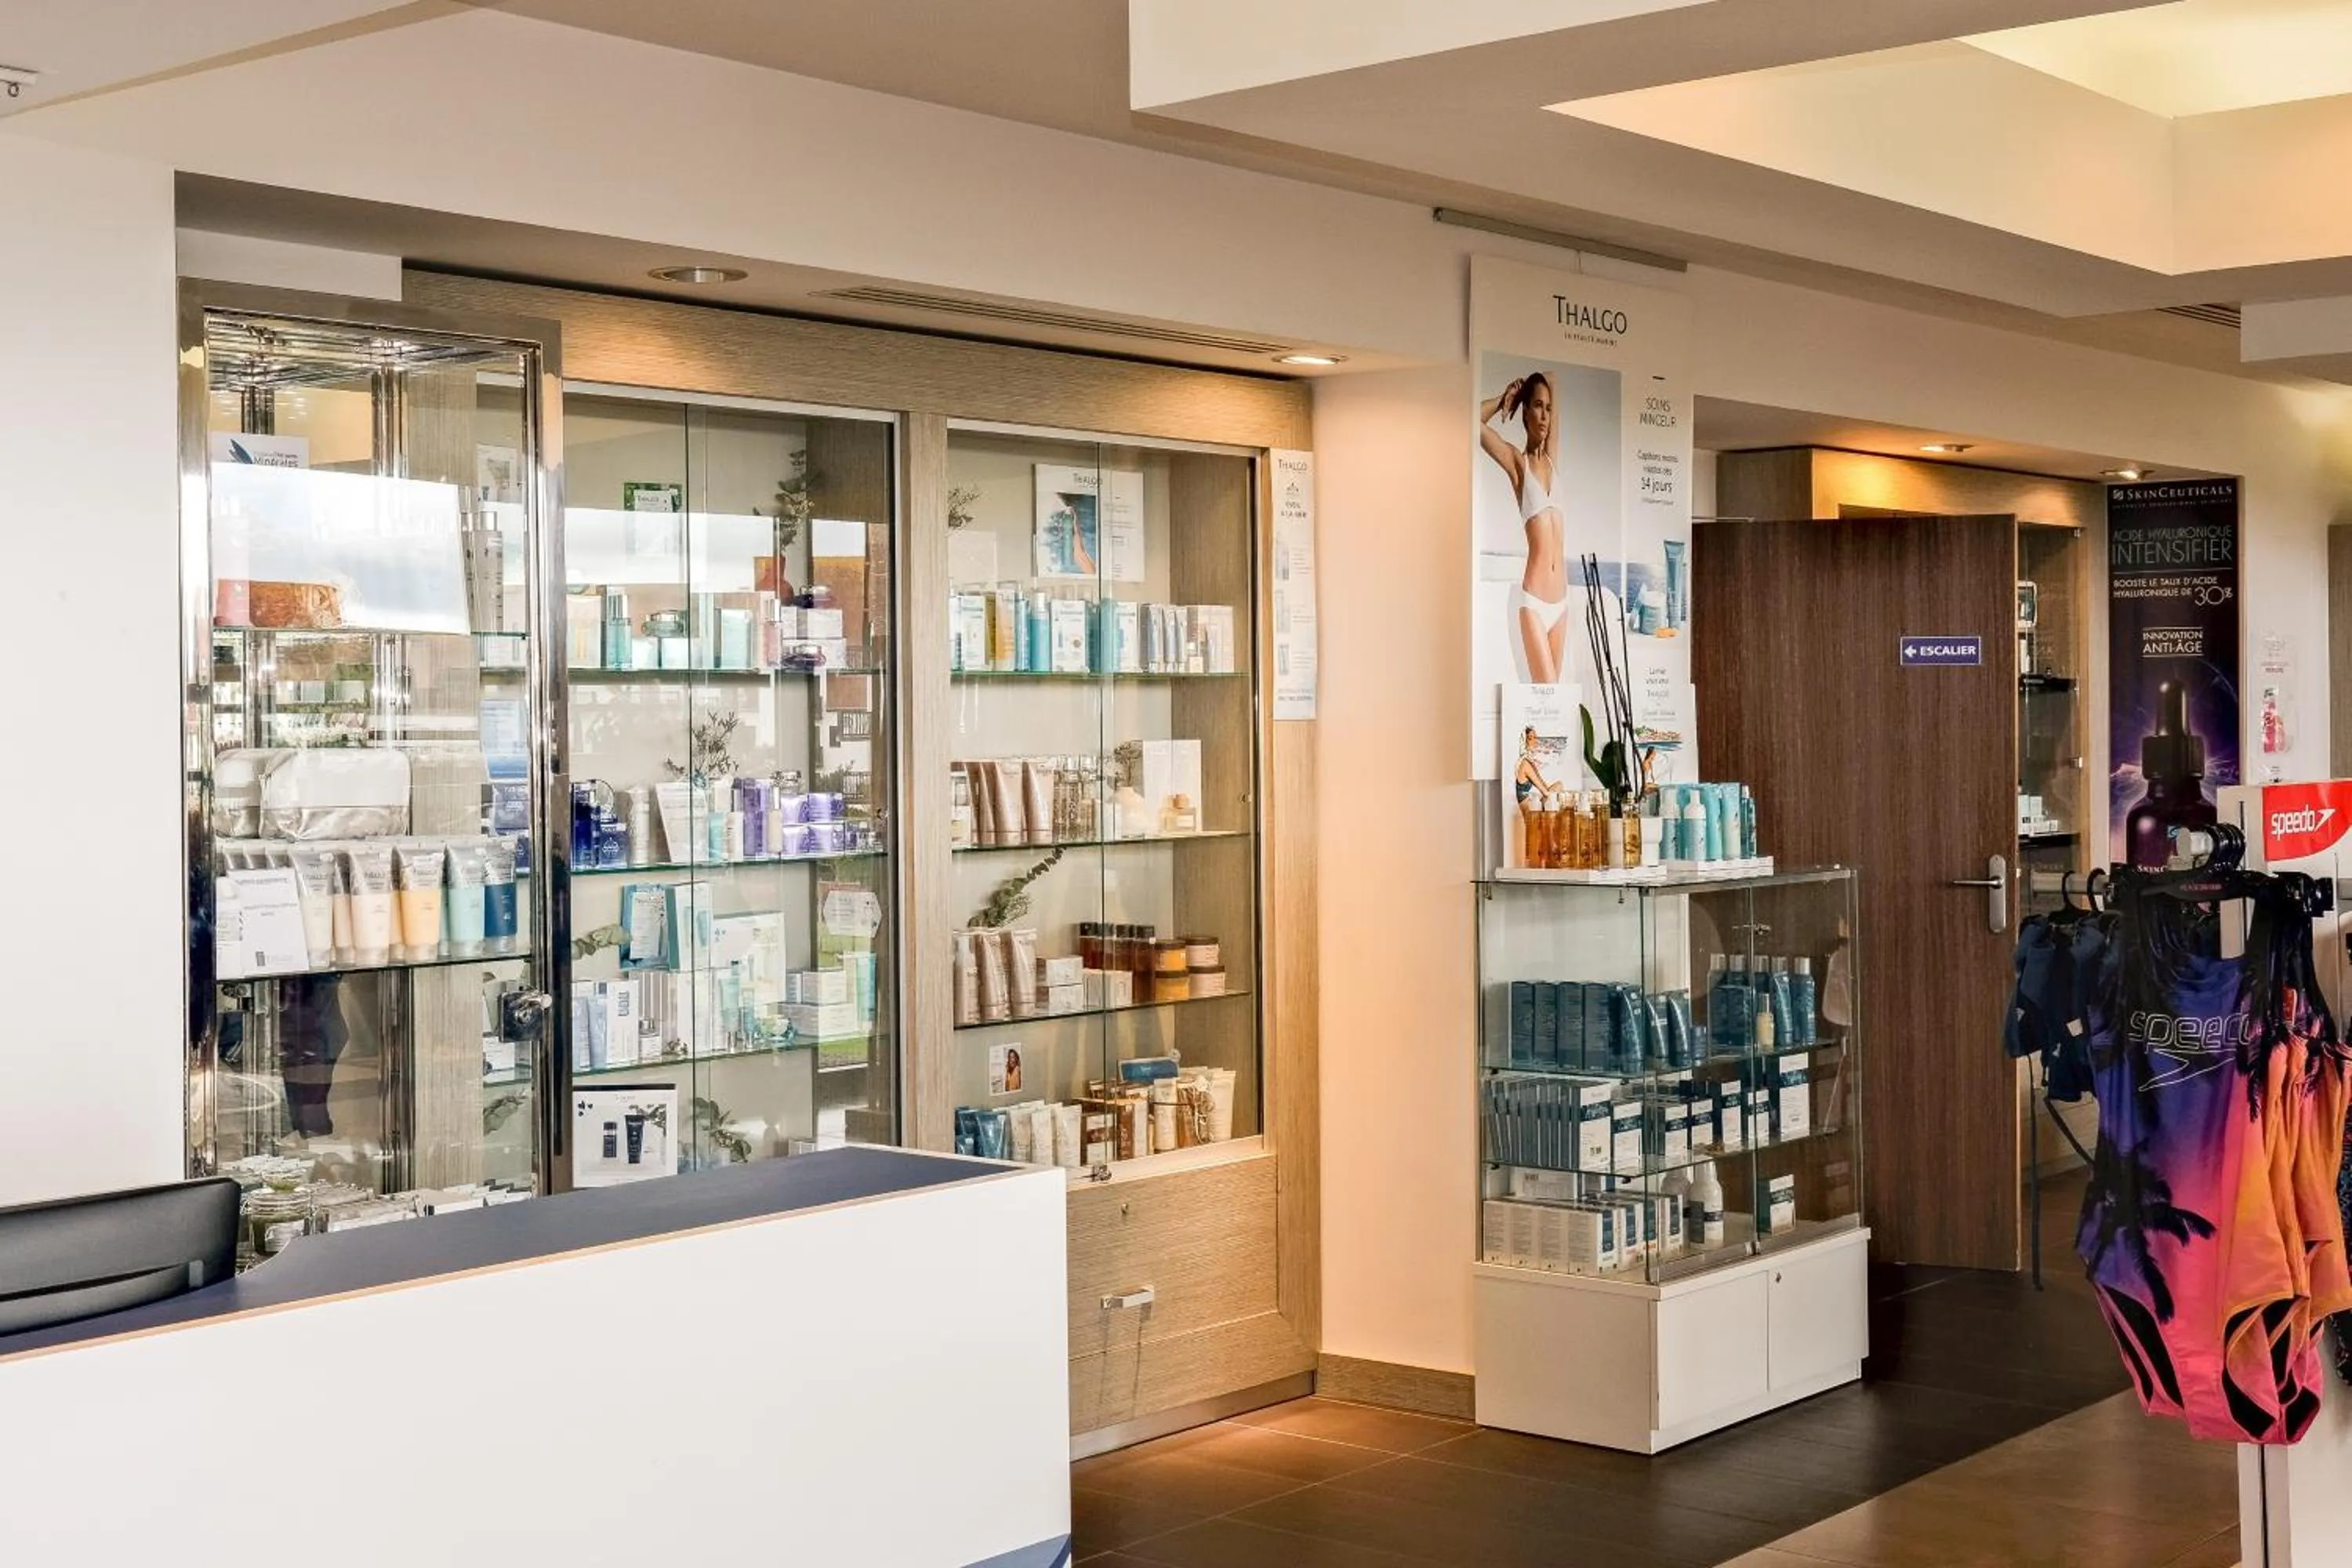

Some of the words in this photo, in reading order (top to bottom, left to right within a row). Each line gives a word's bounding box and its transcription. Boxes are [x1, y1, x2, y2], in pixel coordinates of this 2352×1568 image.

[1553, 295, 1627, 334] THALGO
[1646, 397, 1671, 412] SOINS
[1639, 412, 1677, 427] MINCEUR
[2113, 528, 2144, 543] ACIDE
[2148, 524, 2233, 541] HYALURONIQUE
[2112, 538, 2234, 565] INTENSIFIER
[2114, 578, 2147, 588] BOOSTE
[2149, 577, 2158, 587] LE
[2160, 576, 2182, 586] TAUX
[2183, 575, 2219, 586] D'ACIDE
[2114, 588, 2180, 598] HYALURONIQUE
[2180, 587, 2192, 597] DE
[2194, 586, 2233, 606] 30%
[2143, 630, 2203, 641] INNOVATION
[1920, 645, 1976, 656] ESCALIER
[2143, 639, 2203, 654] ANTI-ÂGE
[2270, 804, 2315, 841] speedo
